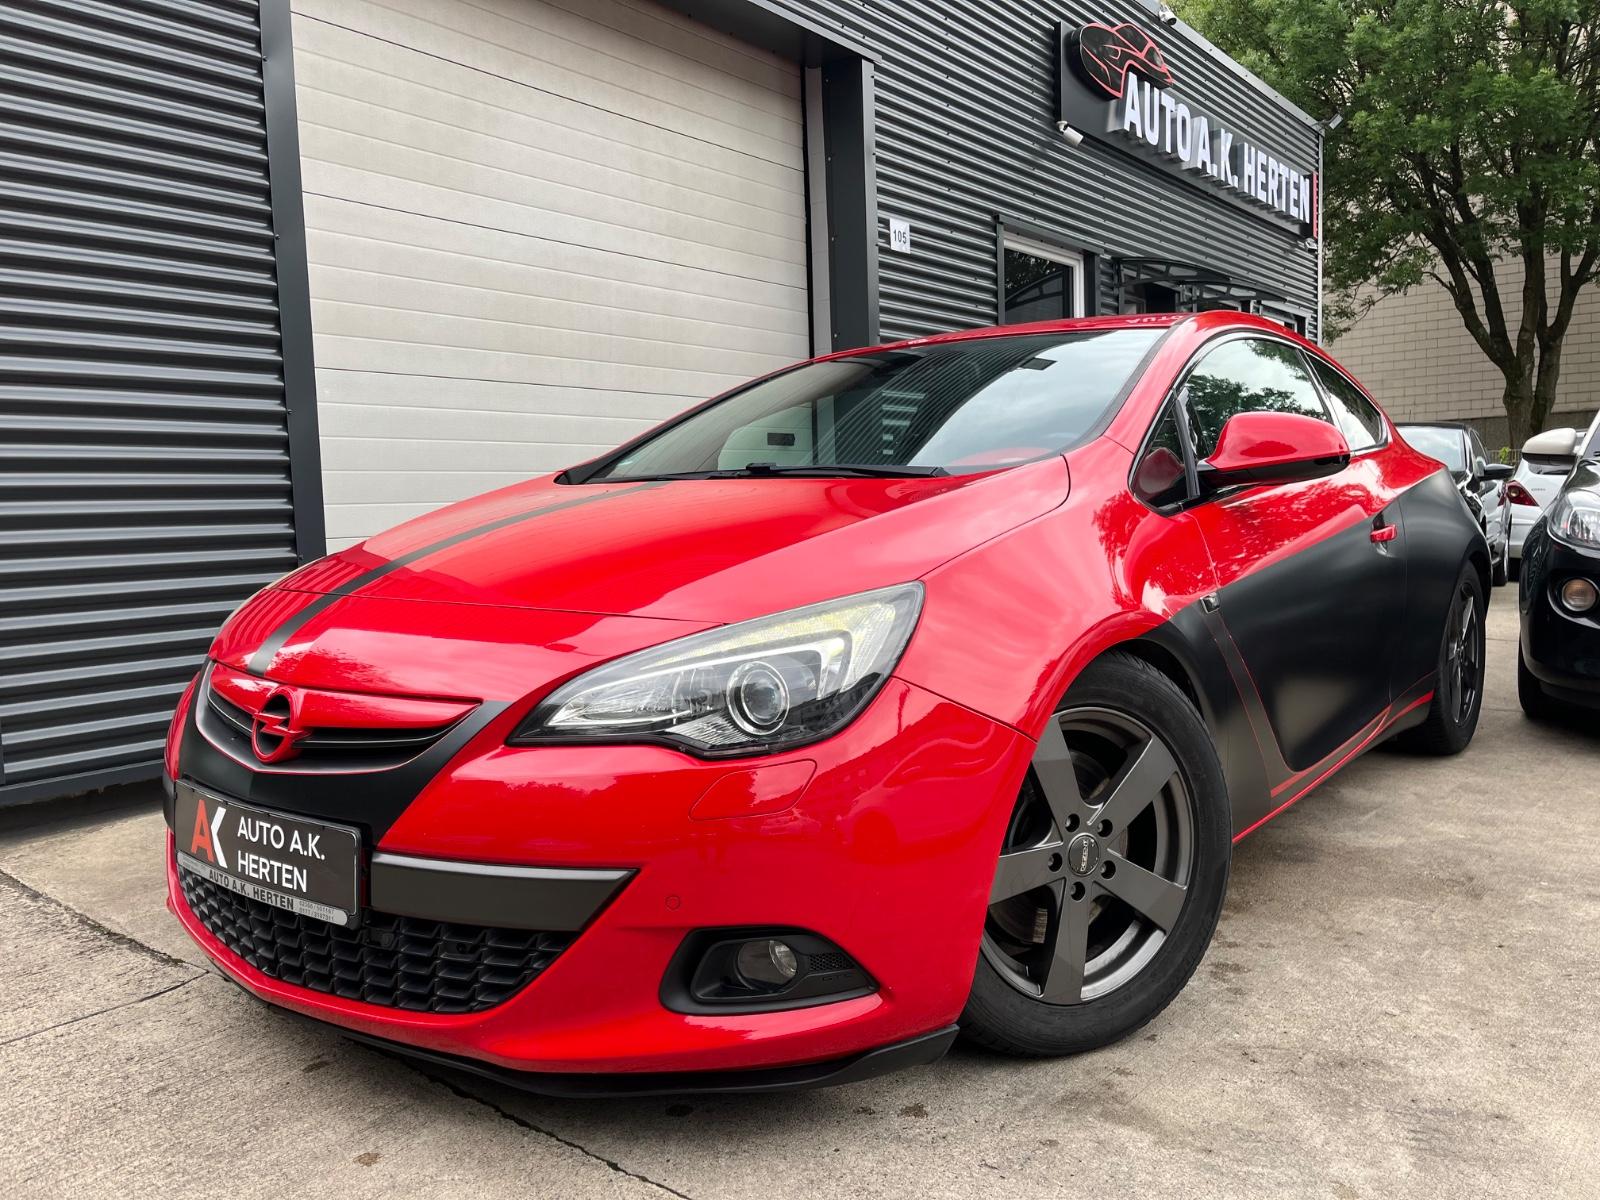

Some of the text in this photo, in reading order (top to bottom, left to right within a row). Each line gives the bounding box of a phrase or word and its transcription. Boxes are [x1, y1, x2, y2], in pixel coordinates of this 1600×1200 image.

[1123, 71, 1310, 224] AUTO A.K. HERTEN
[893, 229, 907, 244] 105
[191, 799, 228, 869] AK
[237, 816, 325, 861] AUTO A.K.
[209, 869, 294, 911] AUTO A.K. HERTEN
[237, 850, 307, 893] HERTEN
